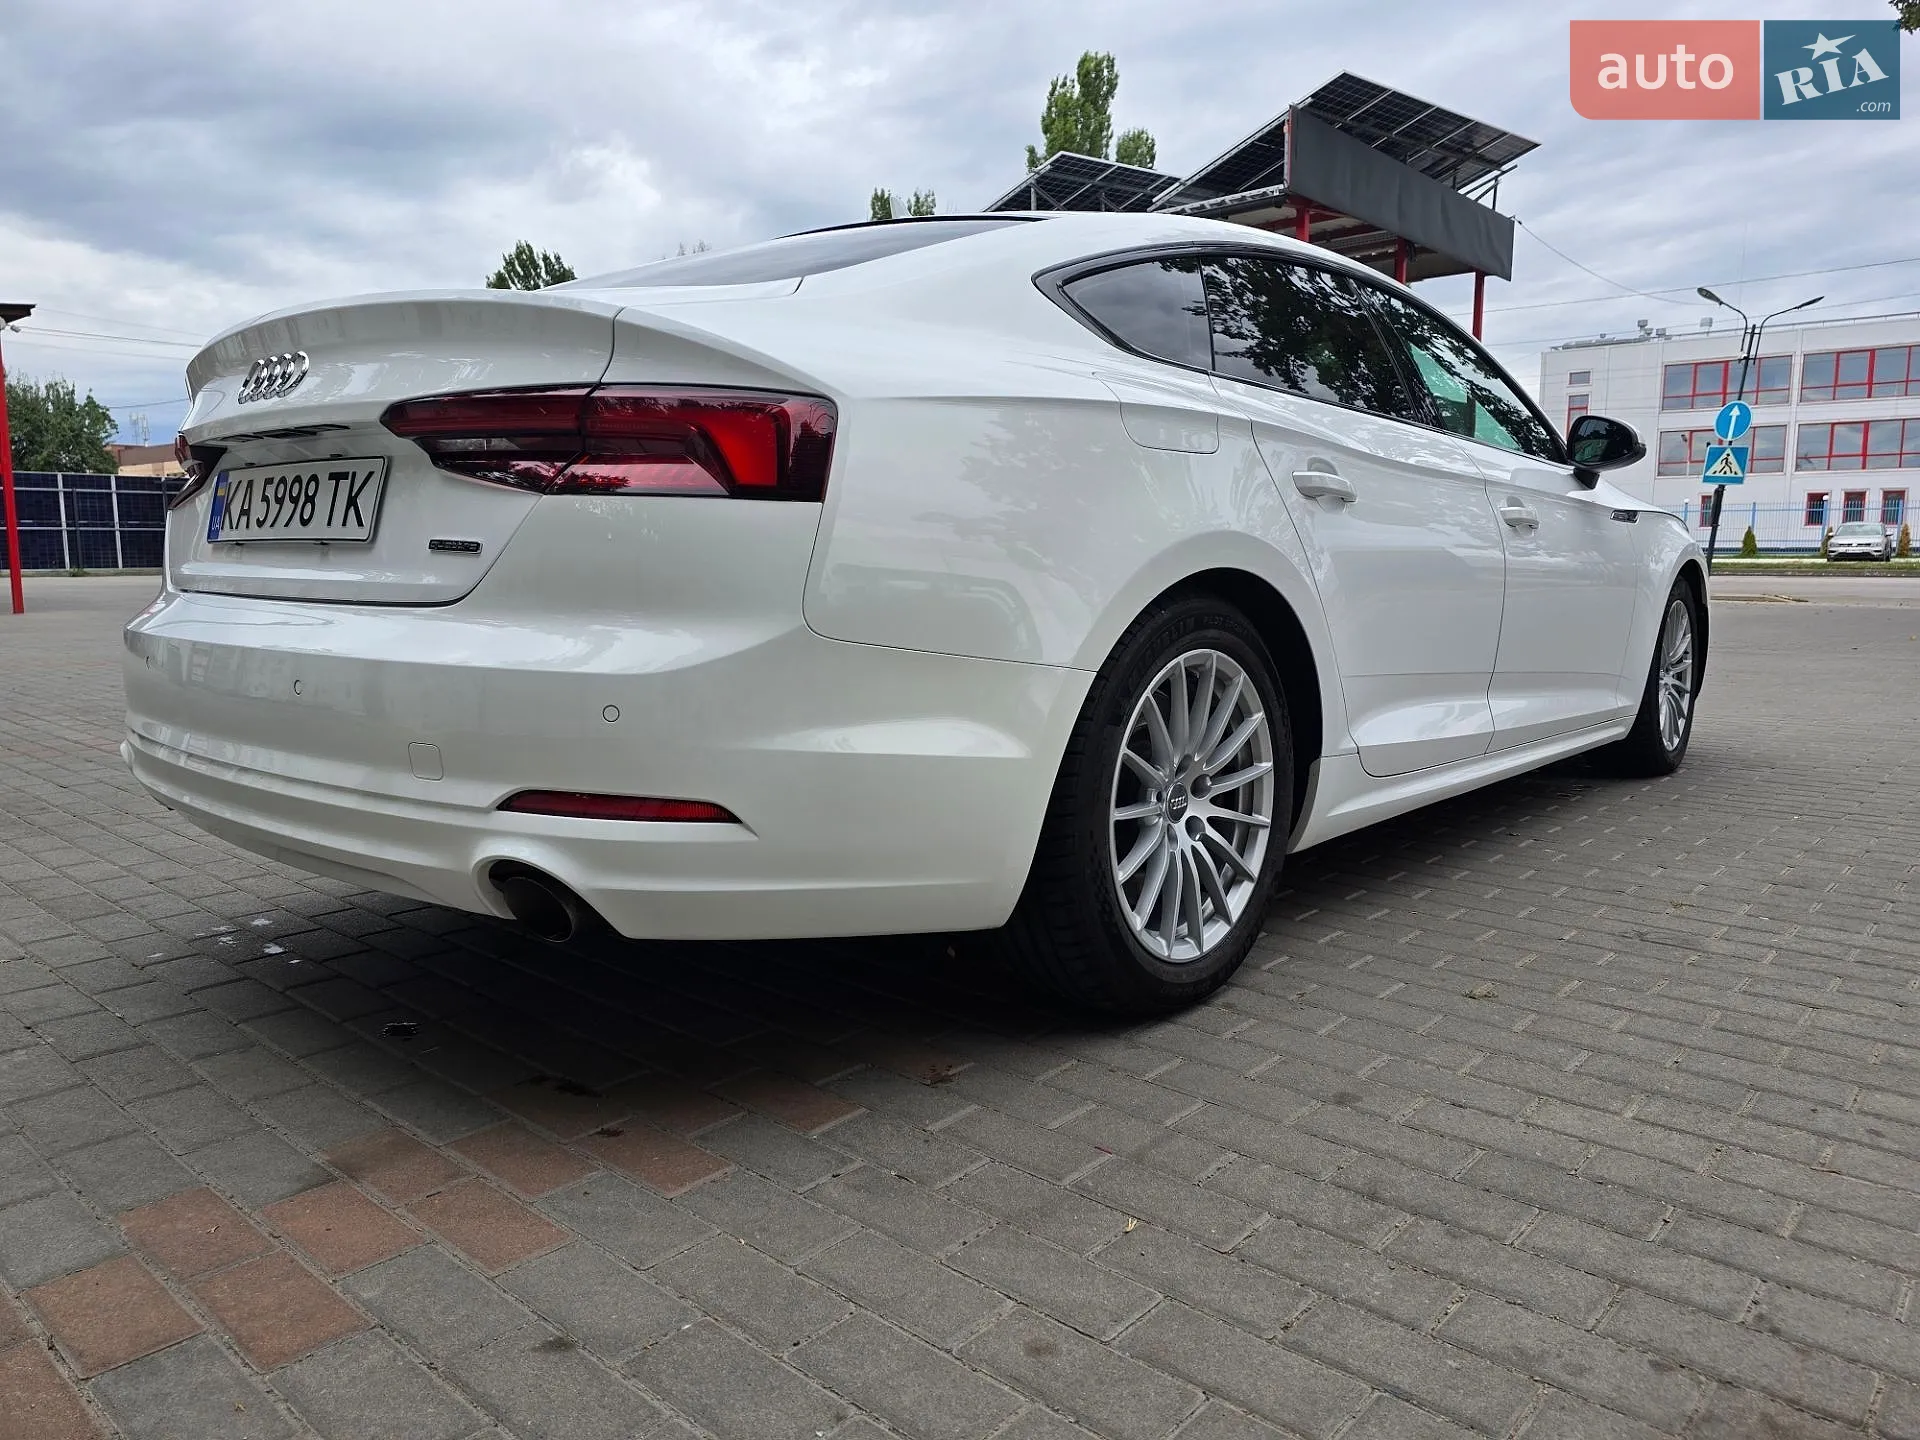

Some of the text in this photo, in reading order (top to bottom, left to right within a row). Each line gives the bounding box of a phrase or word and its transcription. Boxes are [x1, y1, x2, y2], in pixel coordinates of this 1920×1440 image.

[221, 471, 375, 530] KA 5998 TK
